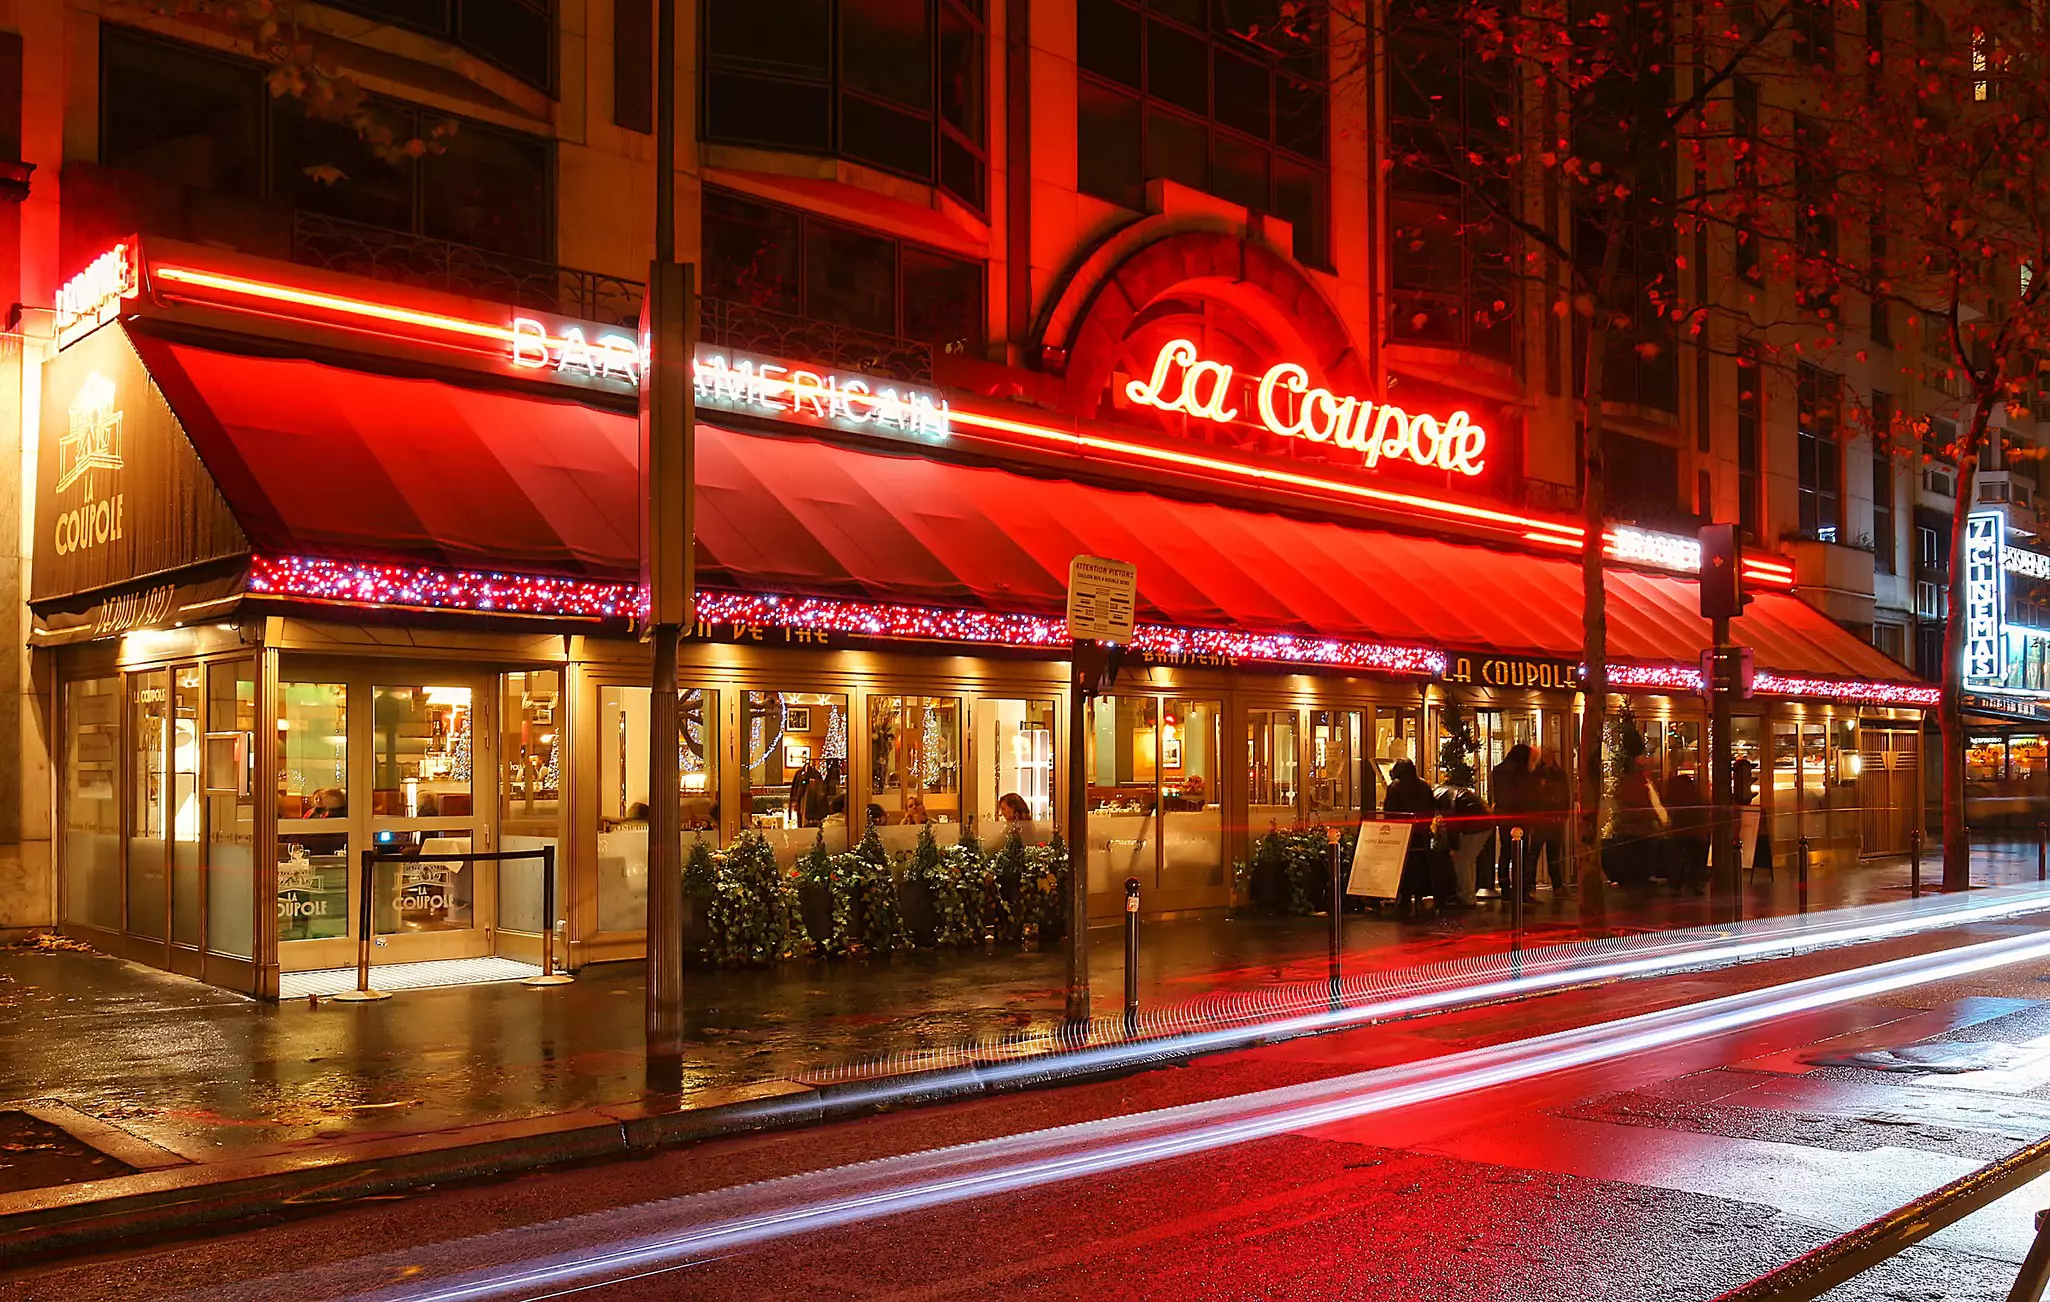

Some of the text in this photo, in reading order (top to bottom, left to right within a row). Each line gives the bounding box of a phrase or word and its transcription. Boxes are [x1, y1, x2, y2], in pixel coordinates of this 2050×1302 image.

[512, 317, 639, 386] BAR
[1125, 338, 1486, 476] La Coupole
[84, 473, 94, 503] LA
[55, 494, 123, 556] COUPOLE
[1075, 562, 1134, 579] ATTENTION PIETONS
[95, 583, 175, 635] DEPUIS 1927
[1971, 546, 1994, 675] CINEMAS
[1441, 657, 1577, 688] LA COUPOLE
[287, 892, 298, 902] LA
[392, 893, 455, 912] COUPOLE
[418, 886, 427, 896] LA
[278, 900, 328, 918] OUPOLE
